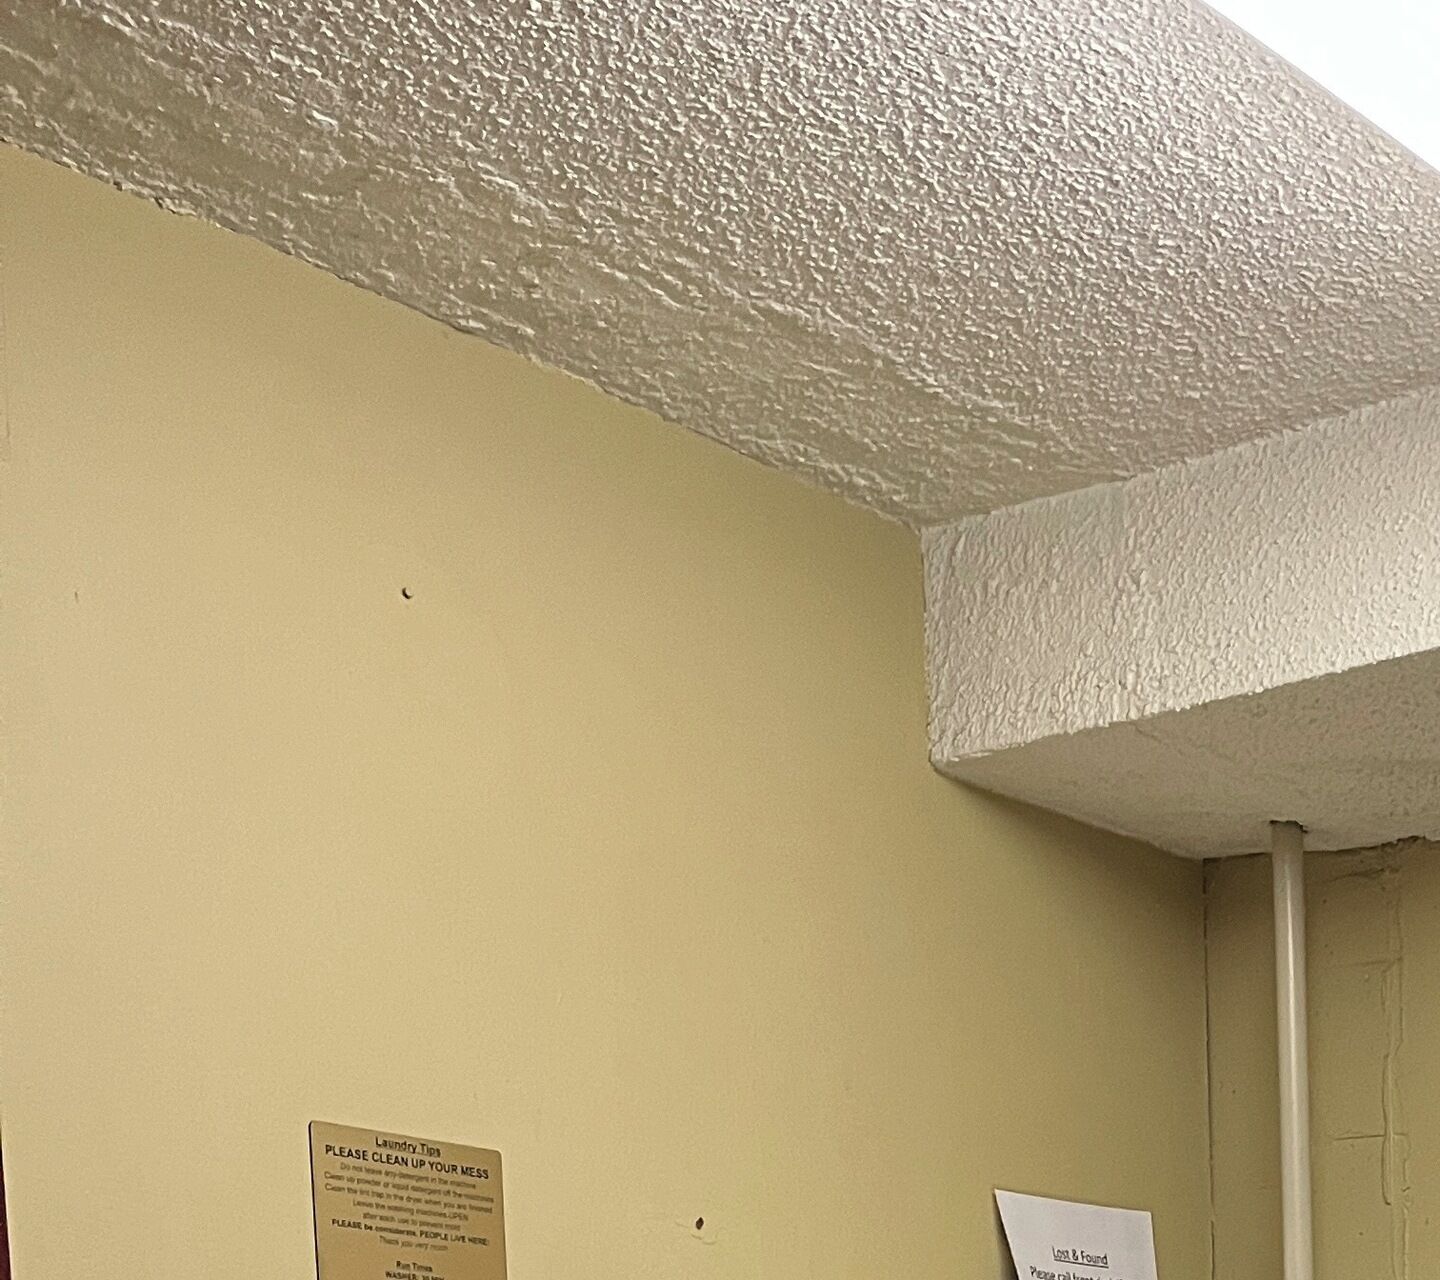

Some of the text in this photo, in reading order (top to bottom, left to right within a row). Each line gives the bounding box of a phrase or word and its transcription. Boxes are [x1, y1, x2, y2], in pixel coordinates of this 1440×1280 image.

[375, 1136, 441, 1158] Laundry Tips
[325, 1144, 489, 1180] PLEASE CLEAN UP YOUR MESS
[1052, 1246, 1108, 1265] Lost & Found
[1029, 1265, 1056, 1280] Please
